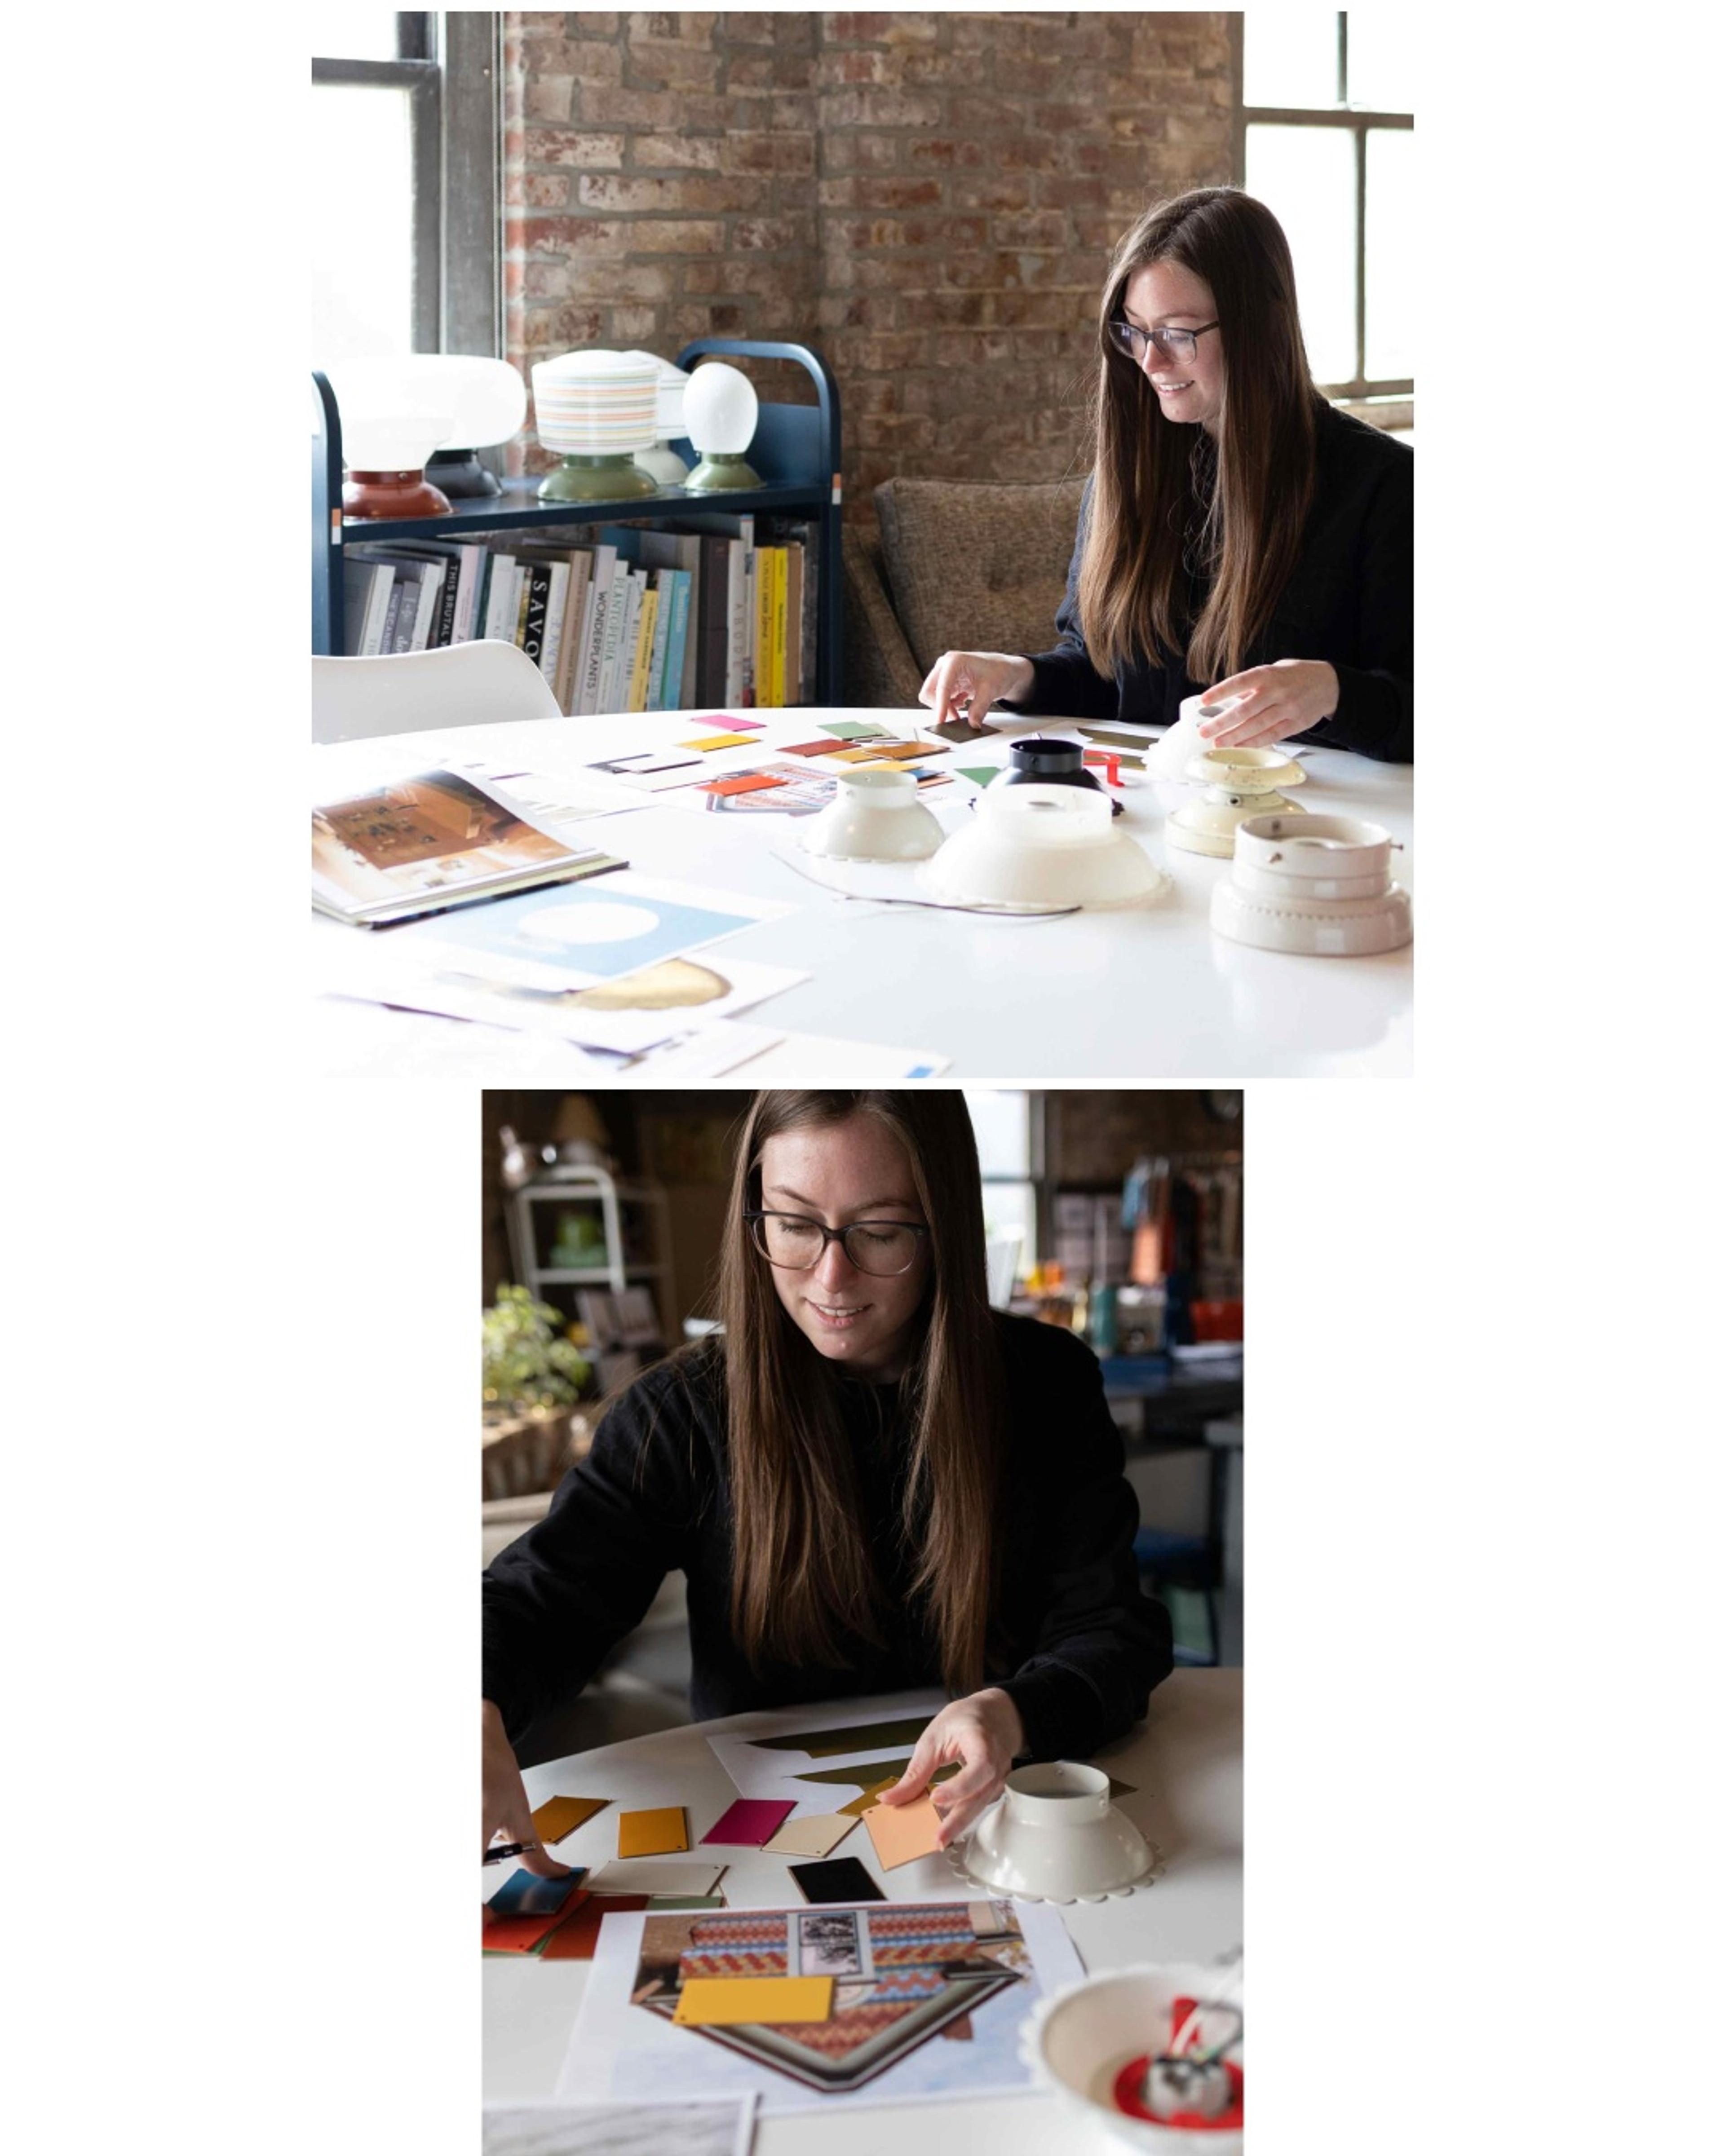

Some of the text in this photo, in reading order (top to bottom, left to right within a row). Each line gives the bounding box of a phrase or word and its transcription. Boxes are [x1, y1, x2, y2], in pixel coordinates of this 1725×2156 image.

[448, 566, 459, 592] THIS
[440, 595, 456, 637] BRUTAL
[586, 591, 608, 689] WONDERPLANTS
[604, 577, 626, 661] PLANTOPEDIA
